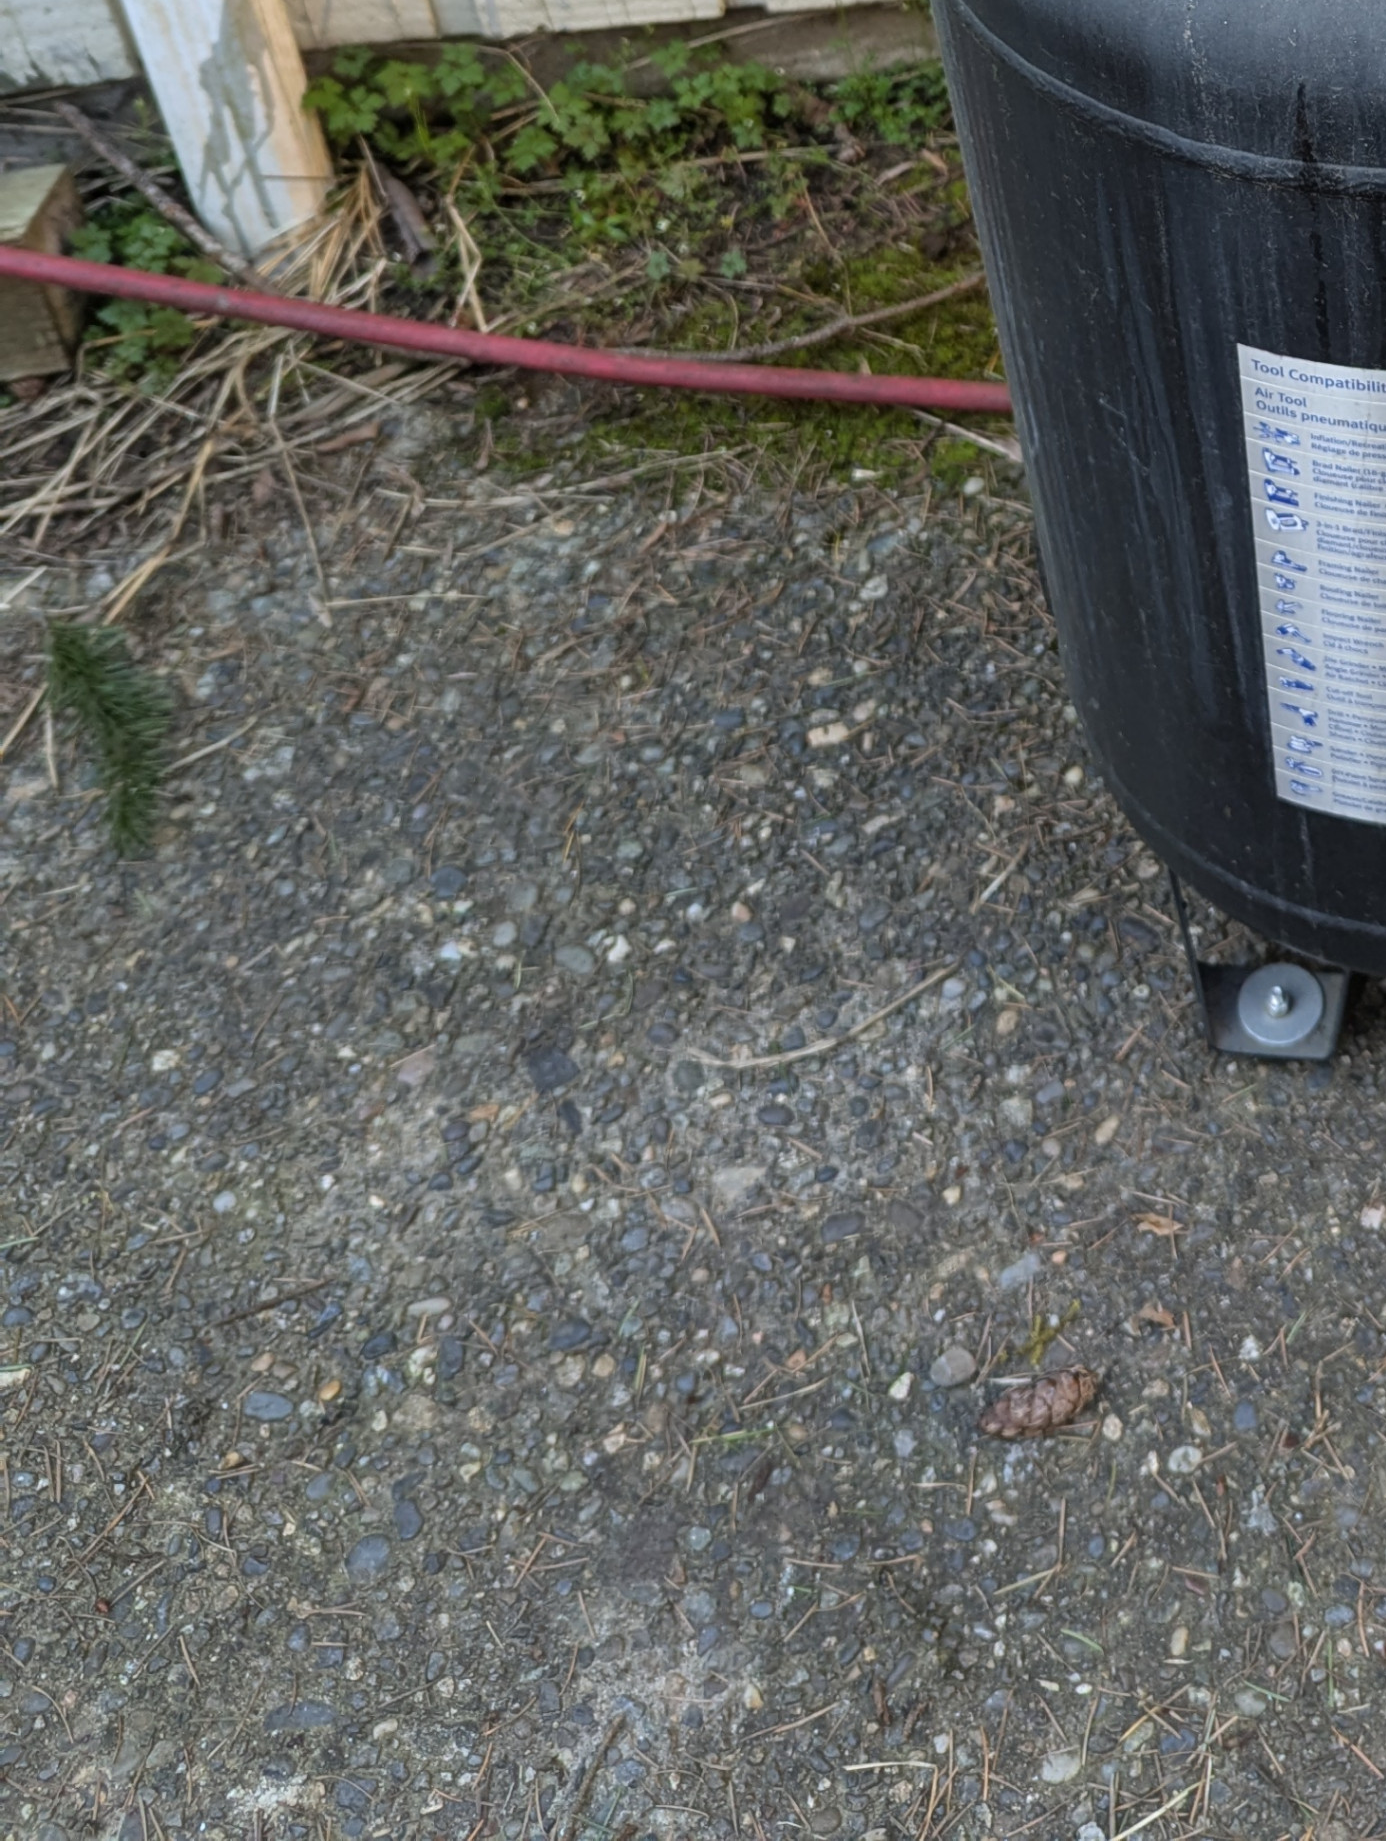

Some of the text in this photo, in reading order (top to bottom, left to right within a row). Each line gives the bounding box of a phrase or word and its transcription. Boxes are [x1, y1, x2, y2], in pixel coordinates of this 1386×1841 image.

[1251, 358, 1284, 378] Tool
[1254, 386, 1308, 408] Air Tool
[1255, 399, 1298, 419] Outils
